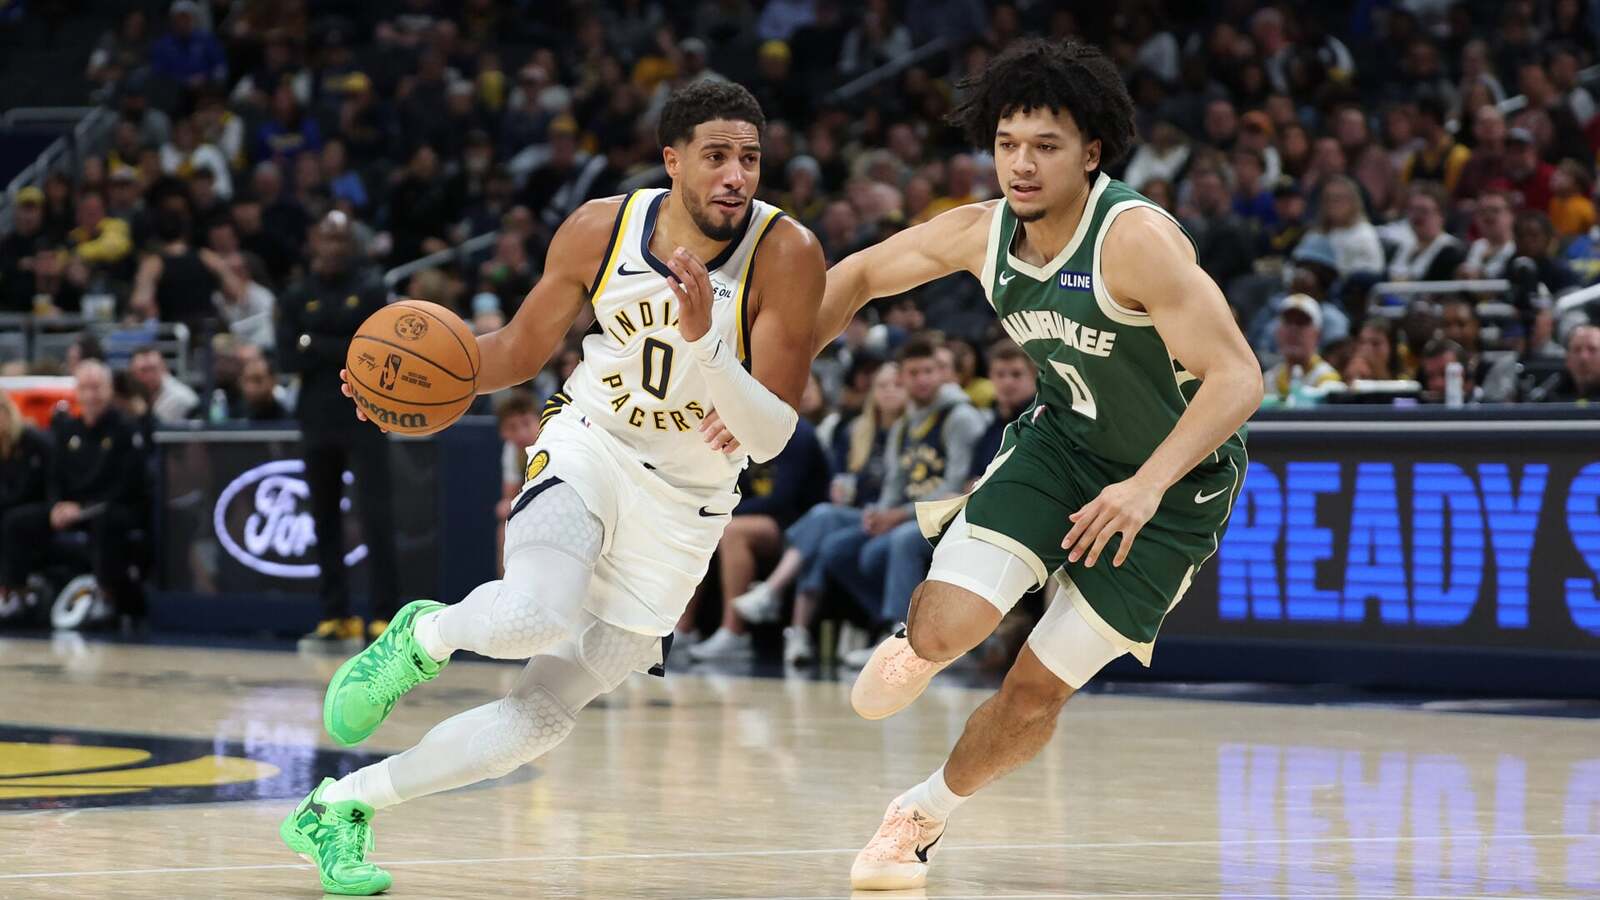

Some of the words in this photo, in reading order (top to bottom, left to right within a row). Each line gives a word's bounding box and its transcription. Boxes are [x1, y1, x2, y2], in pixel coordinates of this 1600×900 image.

[719, 288, 731, 298] OIL
[1060, 272, 1091, 289] ULINE
[607, 299, 680, 347] INDI
[641, 336, 674, 401] 0
[601, 372, 705, 432] PACERS
[244, 475, 317, 557] For
[1218, 460, 1550, 630] READY
